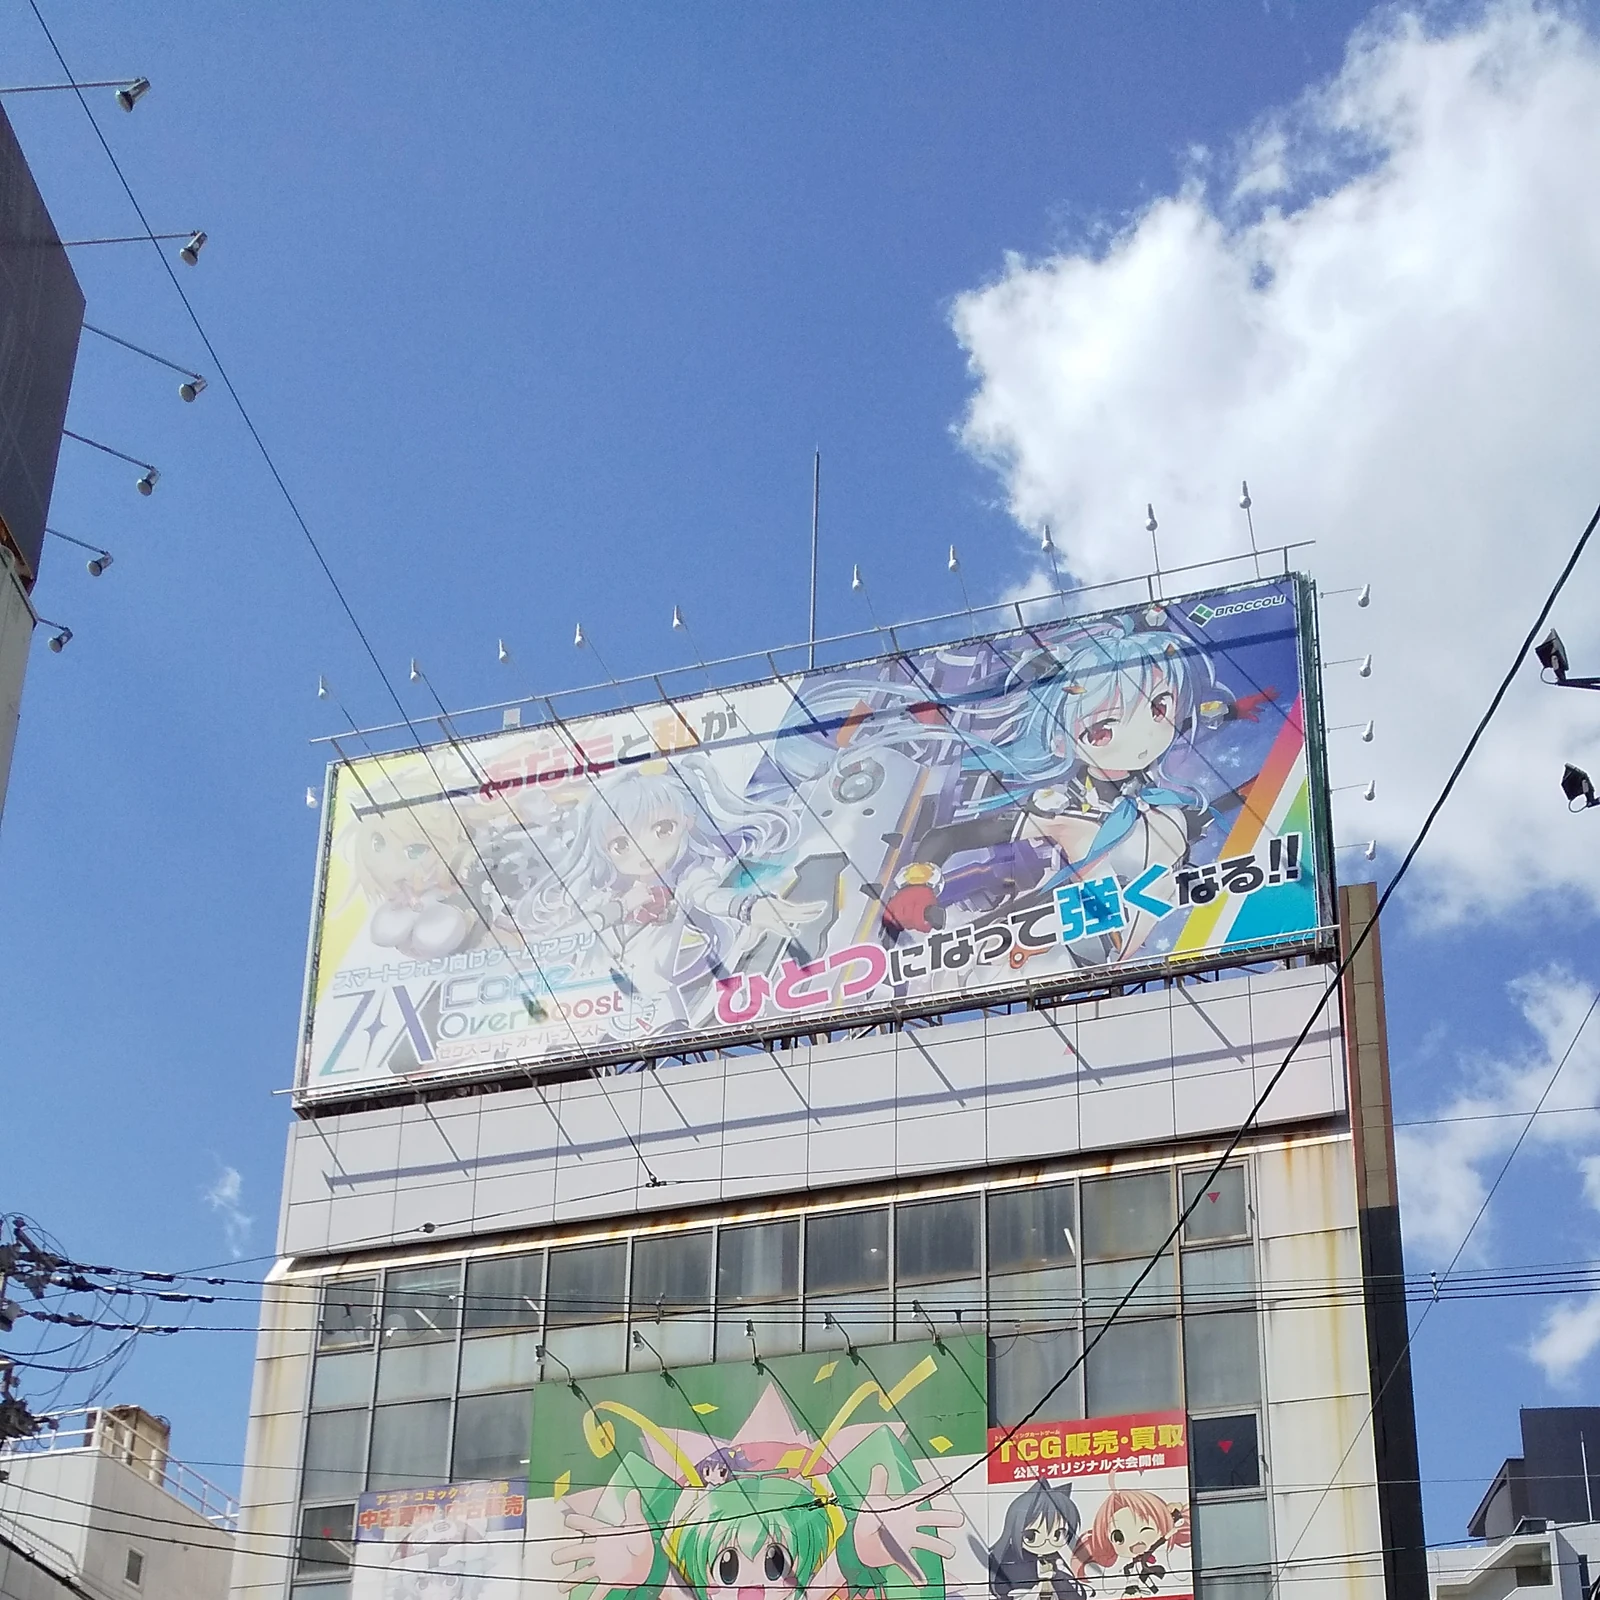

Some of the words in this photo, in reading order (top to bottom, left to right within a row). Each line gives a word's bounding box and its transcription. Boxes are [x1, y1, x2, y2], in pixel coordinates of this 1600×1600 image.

[1214, 595, 1286, 618] BROCCOLI
[480, 704, 738, 803] あなたと私が
[333, 932, 598, 990] スマートフォン向けゲームアプリ
